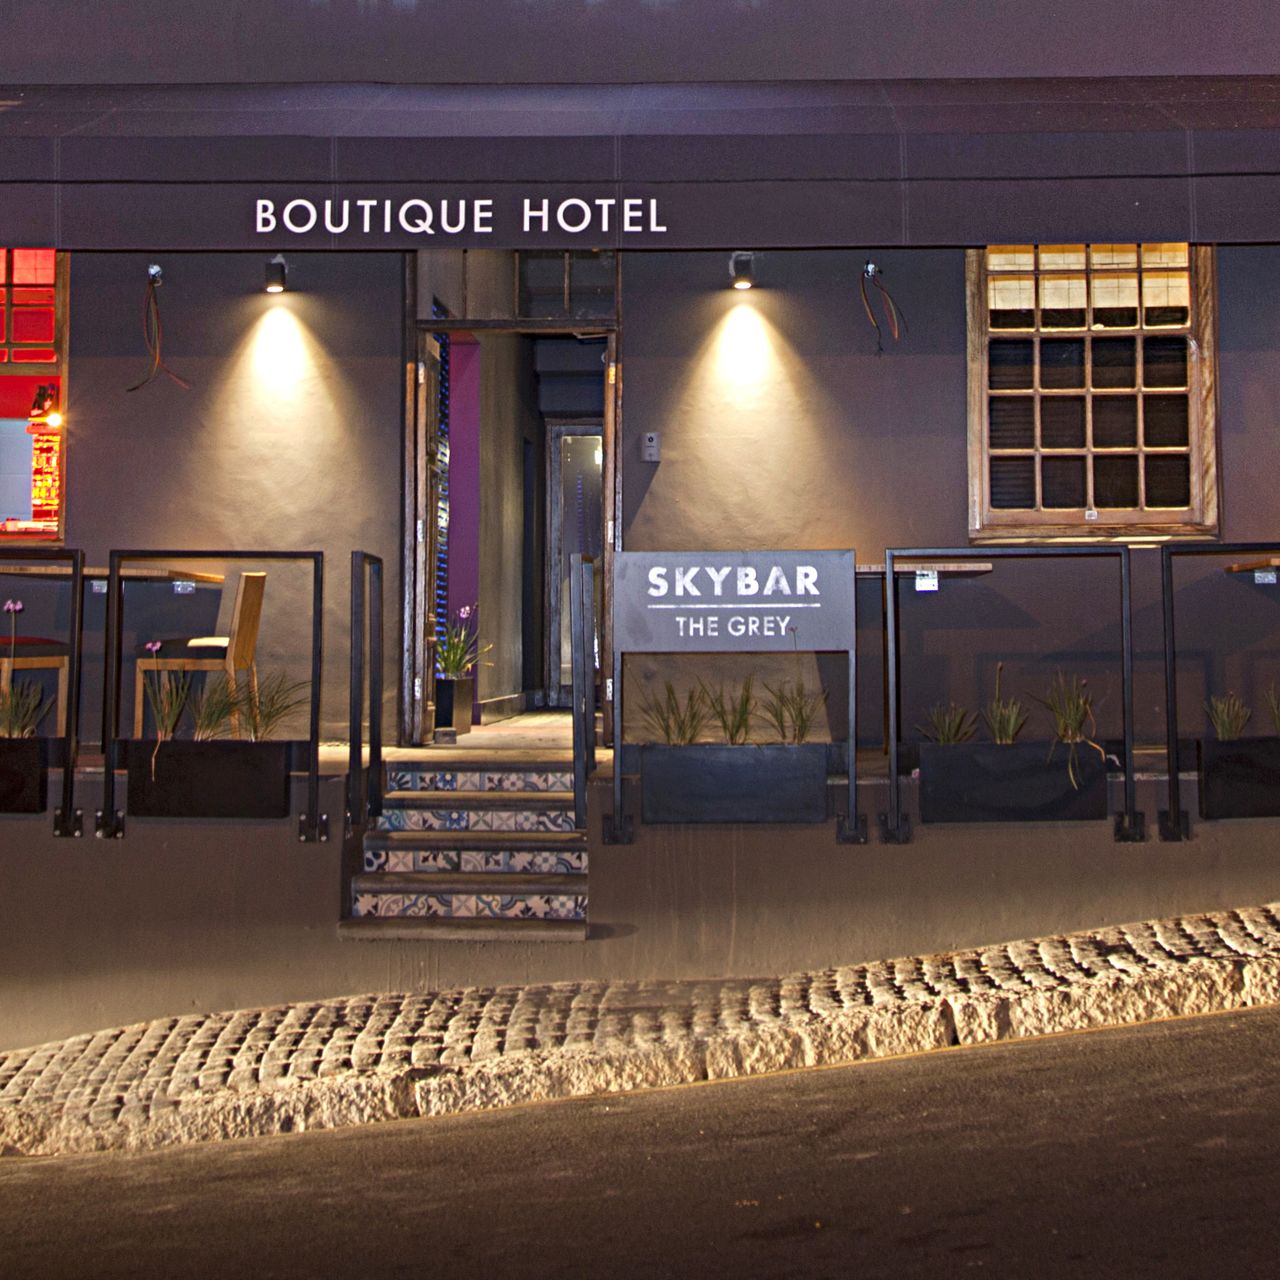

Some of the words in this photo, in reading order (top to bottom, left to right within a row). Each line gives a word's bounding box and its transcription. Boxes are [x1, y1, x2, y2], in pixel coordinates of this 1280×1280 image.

[256, 198, 493, 235] BOUTIQUE
[523, 198, 667, 233] HOTEL
[647, 565, 821, 597] SKYBAR
[675, 615, 719, 637] THE
[727, 615, 791, 637] GREY
